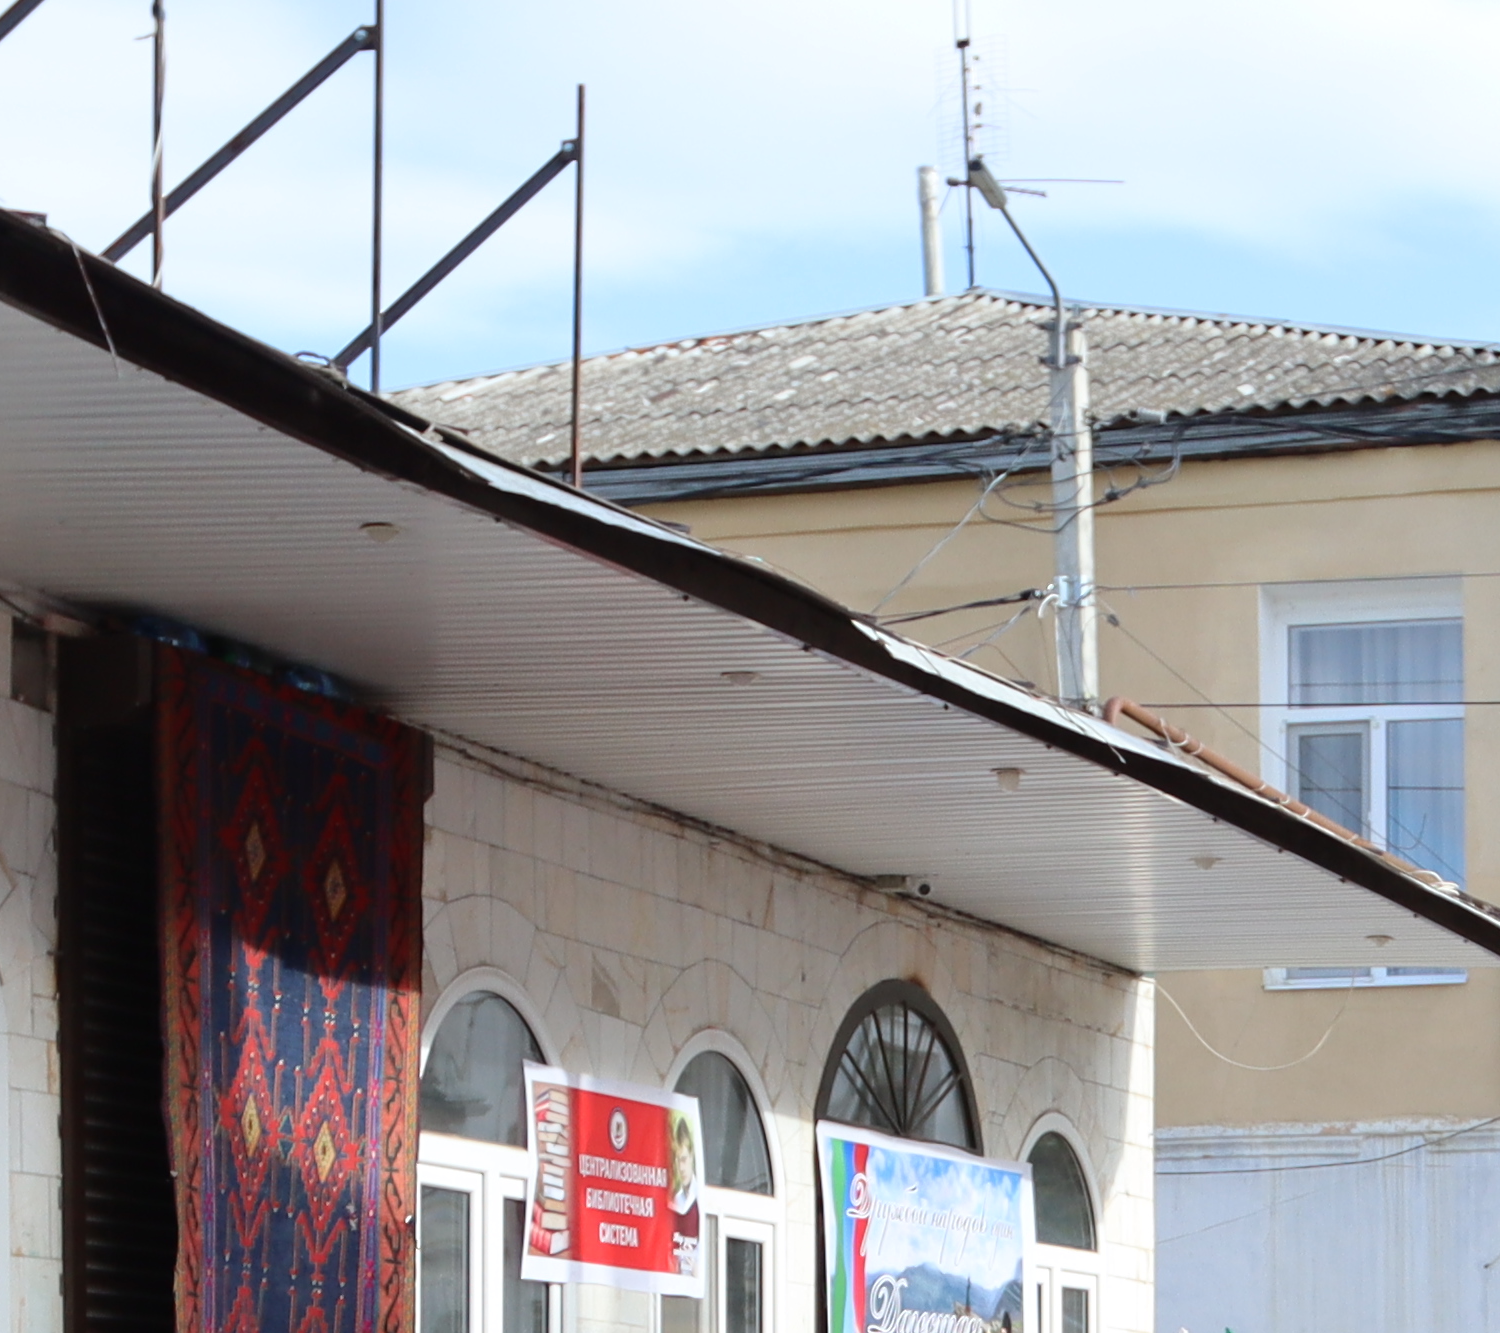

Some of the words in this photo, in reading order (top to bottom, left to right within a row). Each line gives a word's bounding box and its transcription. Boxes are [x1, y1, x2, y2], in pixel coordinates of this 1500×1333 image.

[578, 1153, 668, 1188] ЦЕНТРАЛИЗОВАННАЯ
[586, 1187, 655, 1219] БИБЛИОТЕЧНАЯ
[599, 1222, 639, 1248] СИСТЕМА
